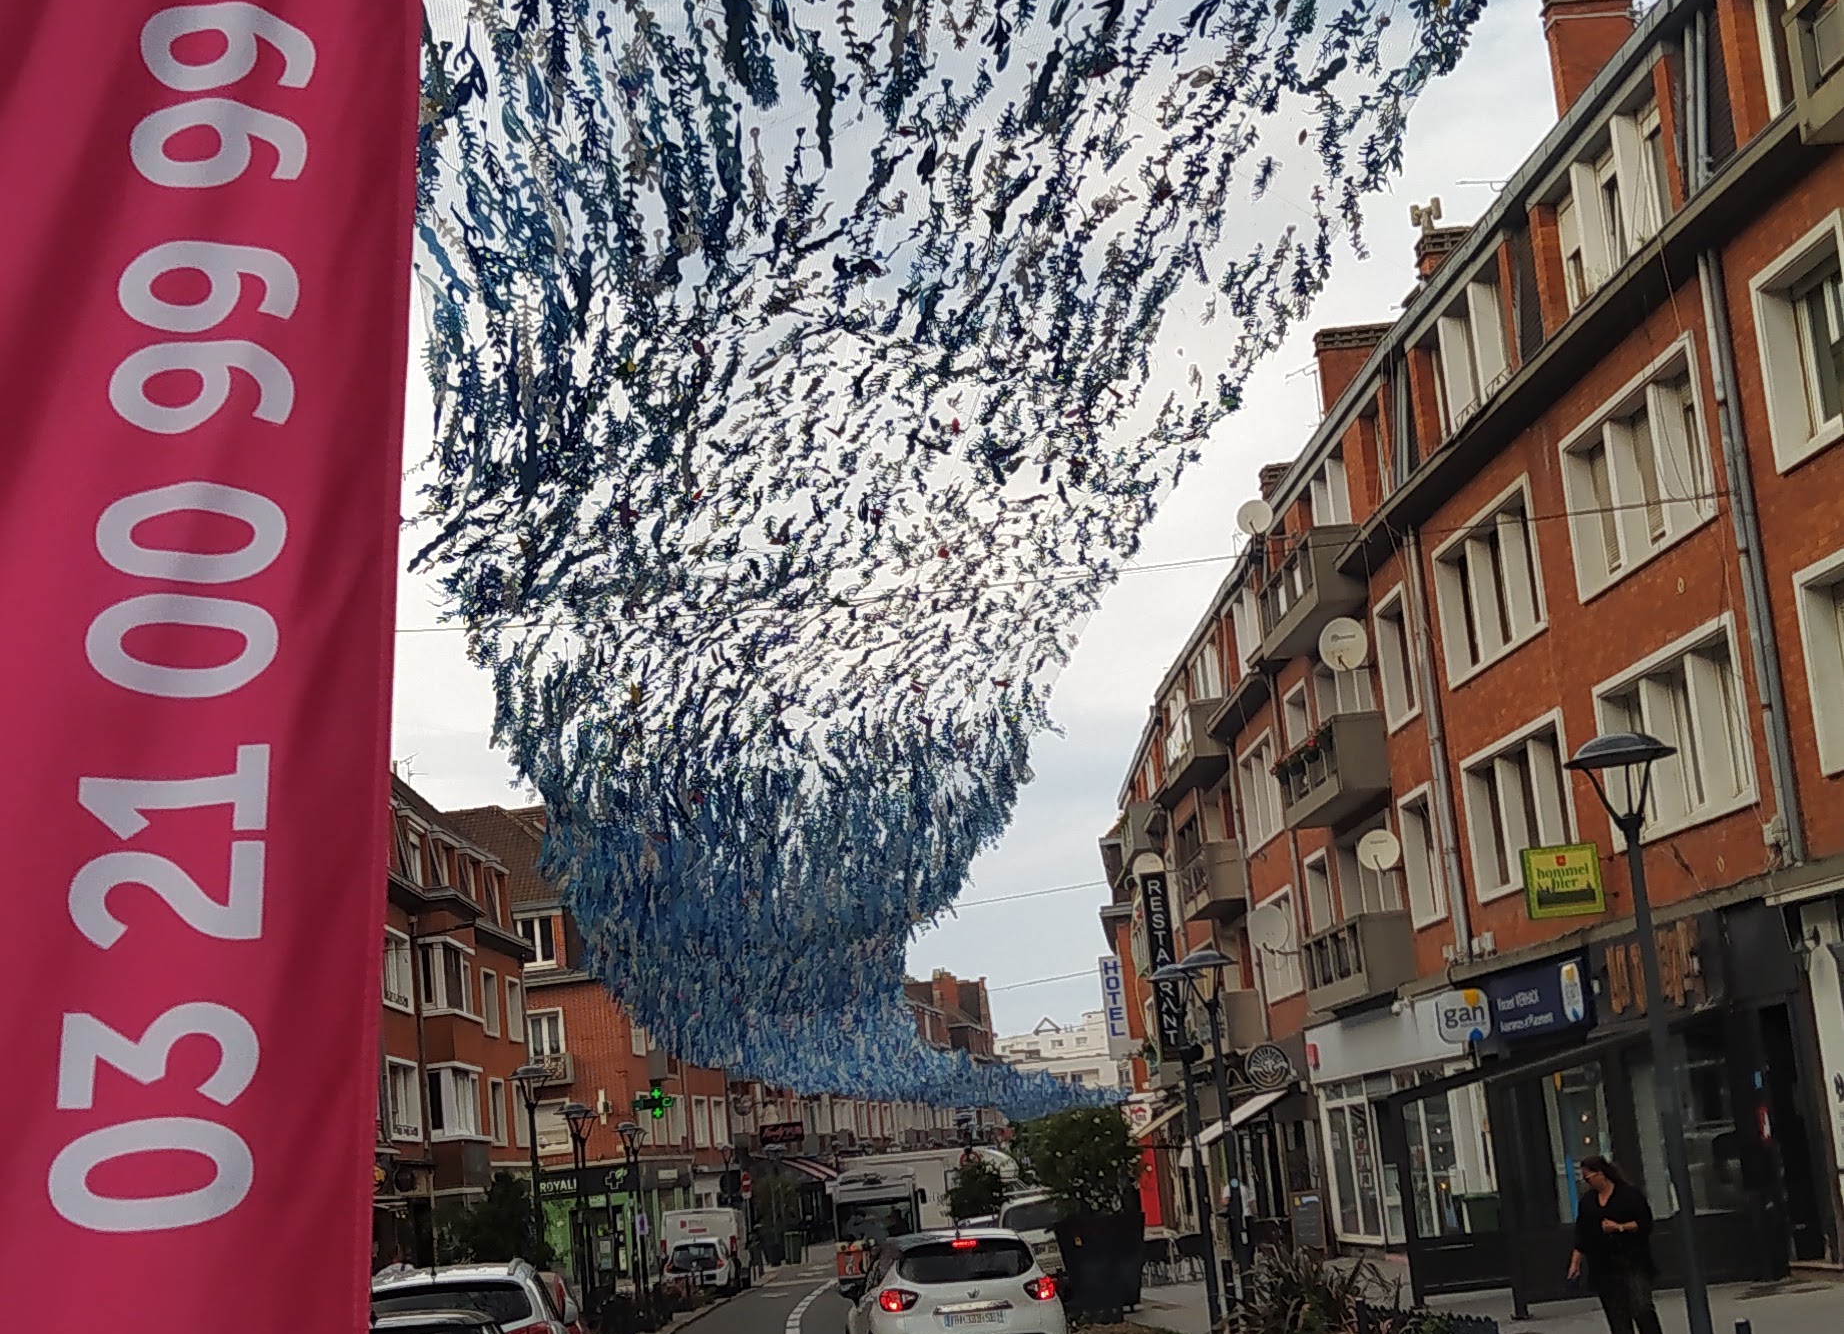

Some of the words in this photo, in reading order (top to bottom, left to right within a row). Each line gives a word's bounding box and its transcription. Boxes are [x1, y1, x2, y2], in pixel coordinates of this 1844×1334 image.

[129, 1, 317, 188] 99
[108, 240, 300, 434] 99
[85, 480, 288, 699] 00
[68, 743, 271, 950] 21
[1536, 862, 1589, 880] hommel
[1103, 960, 1126, 1037] HOTEL
[1147, 879, 1178, 1046] RESTARANT
[1443, 1005, 1486, 1030] gan
[48, 1001, 260, 1233] 03
